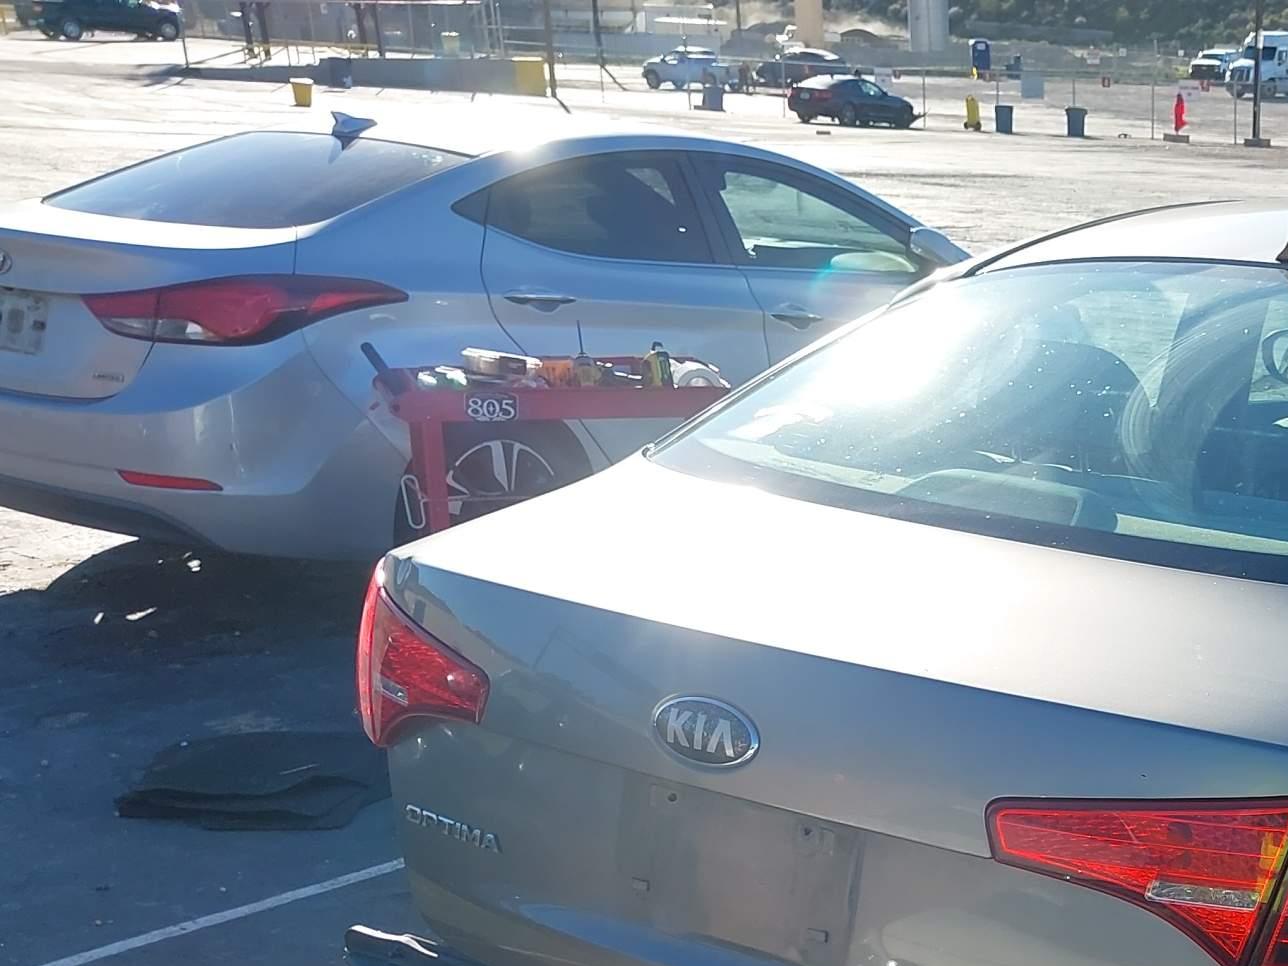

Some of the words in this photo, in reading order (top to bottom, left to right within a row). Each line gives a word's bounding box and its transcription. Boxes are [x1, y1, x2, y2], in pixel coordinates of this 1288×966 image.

[467, 397, 515, 420] 805
[666, 706, 735, 758] KIA
[405, 803, 501, 854] OPTIMA
